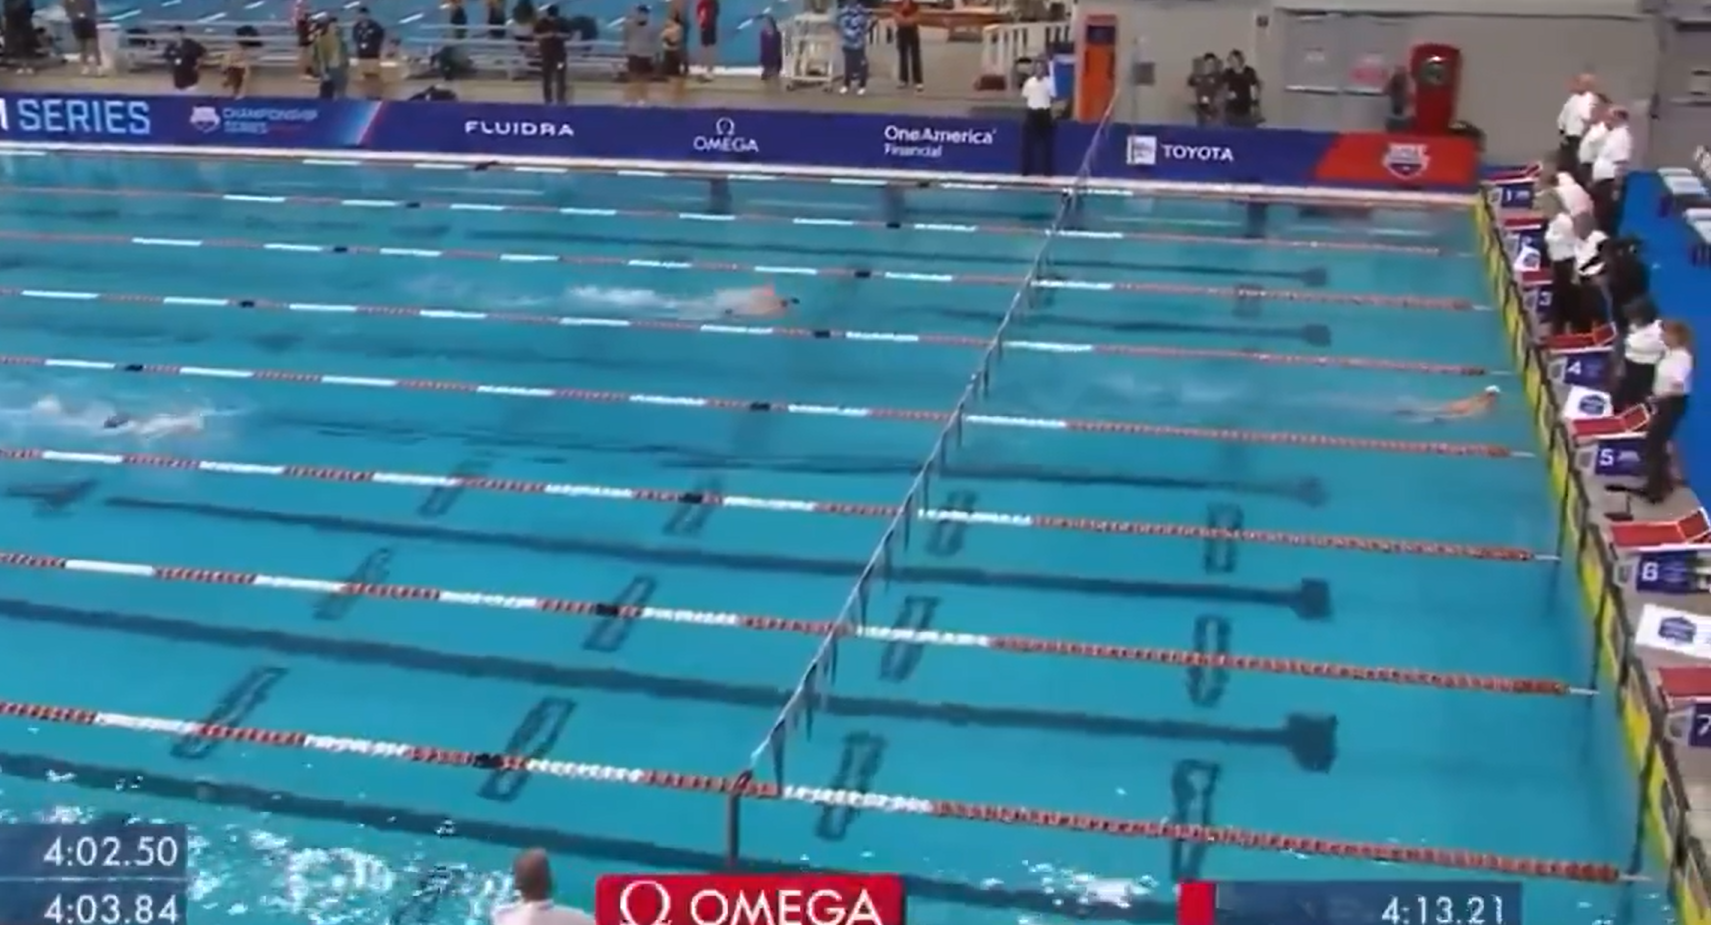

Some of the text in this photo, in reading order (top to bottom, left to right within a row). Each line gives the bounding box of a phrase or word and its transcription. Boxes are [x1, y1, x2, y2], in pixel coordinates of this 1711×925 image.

[17, 98, 150, 134] SERIES
[465, 120, 574, 137] FLUIDRA
[693, 135, 759, 153] OMEGA
[1161, 144, 1235, 162] TOYOTA
[1567, 361, 1582, 375] 4
[1600, 448, 1614, 466] 5
[1642, 562, 1659, 580] 6
